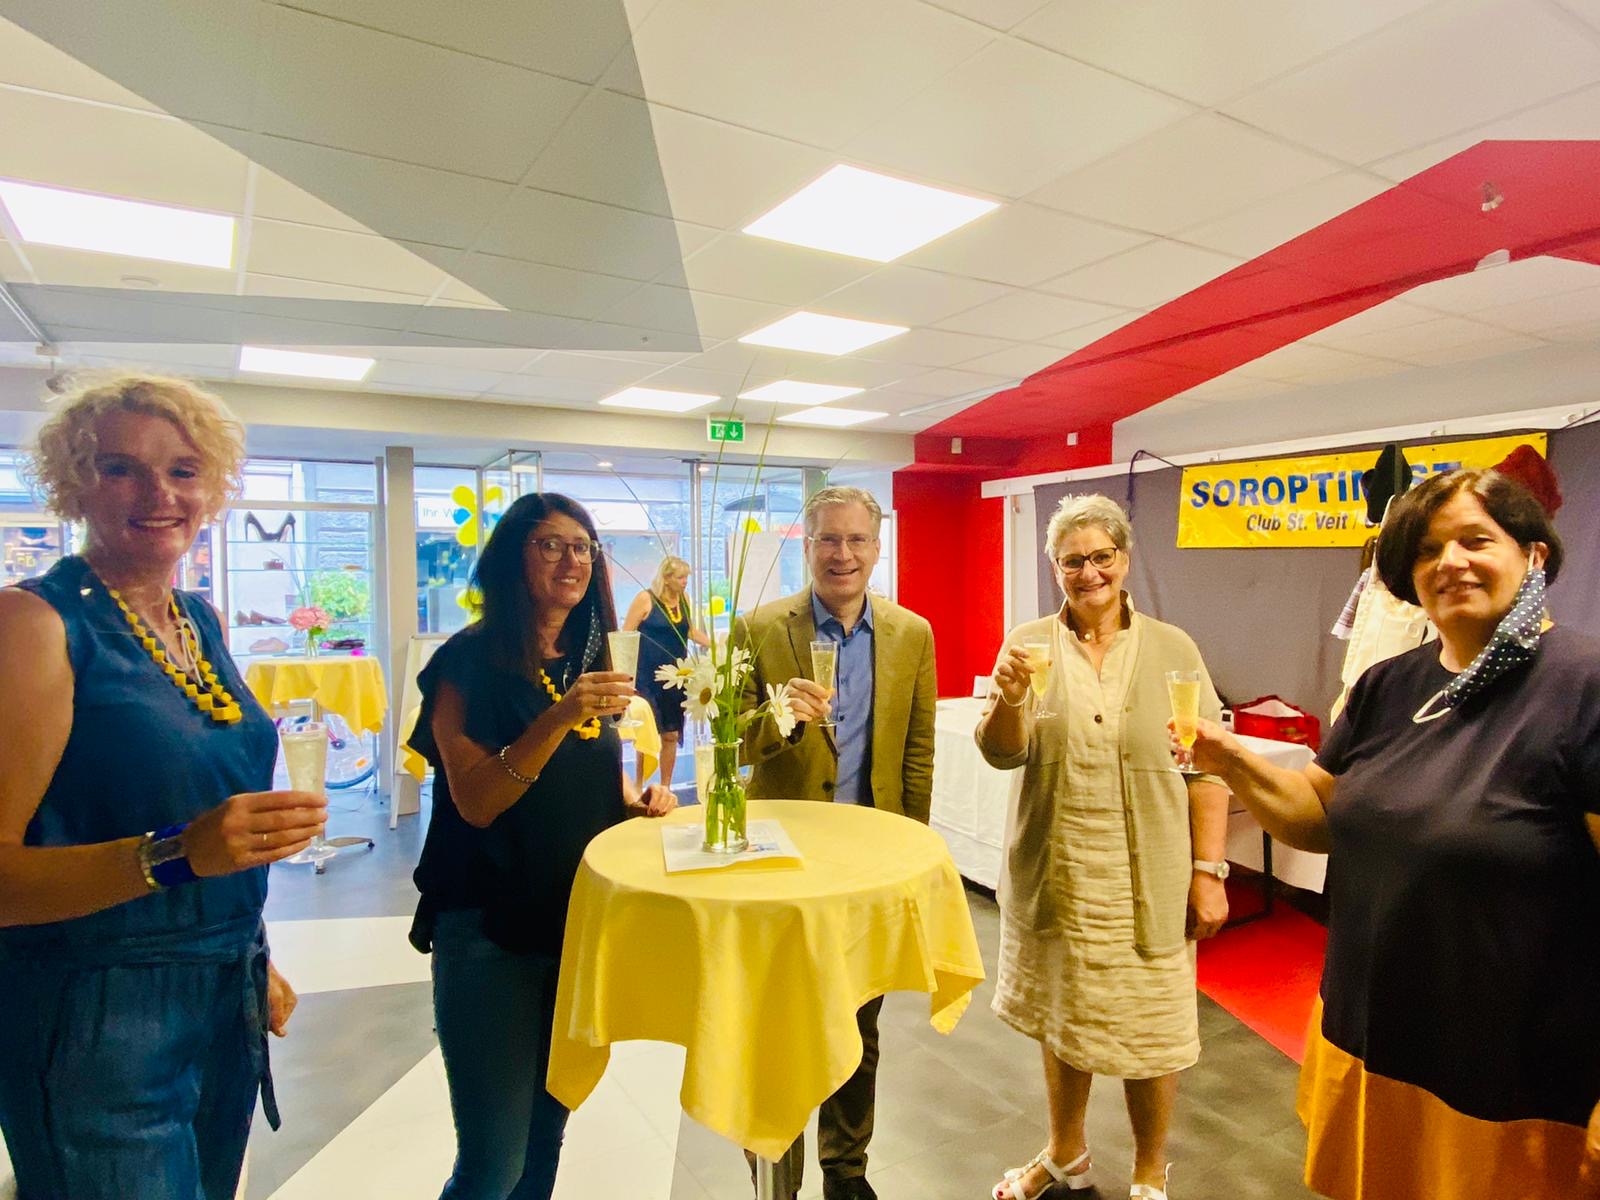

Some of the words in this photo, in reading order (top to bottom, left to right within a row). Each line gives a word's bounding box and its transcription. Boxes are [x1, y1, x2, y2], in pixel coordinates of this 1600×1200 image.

[1246, 513, 1281, 532] Club
[1287, 513, 1308, 531] St.
[1315, 511, 1348, 530] Veit
